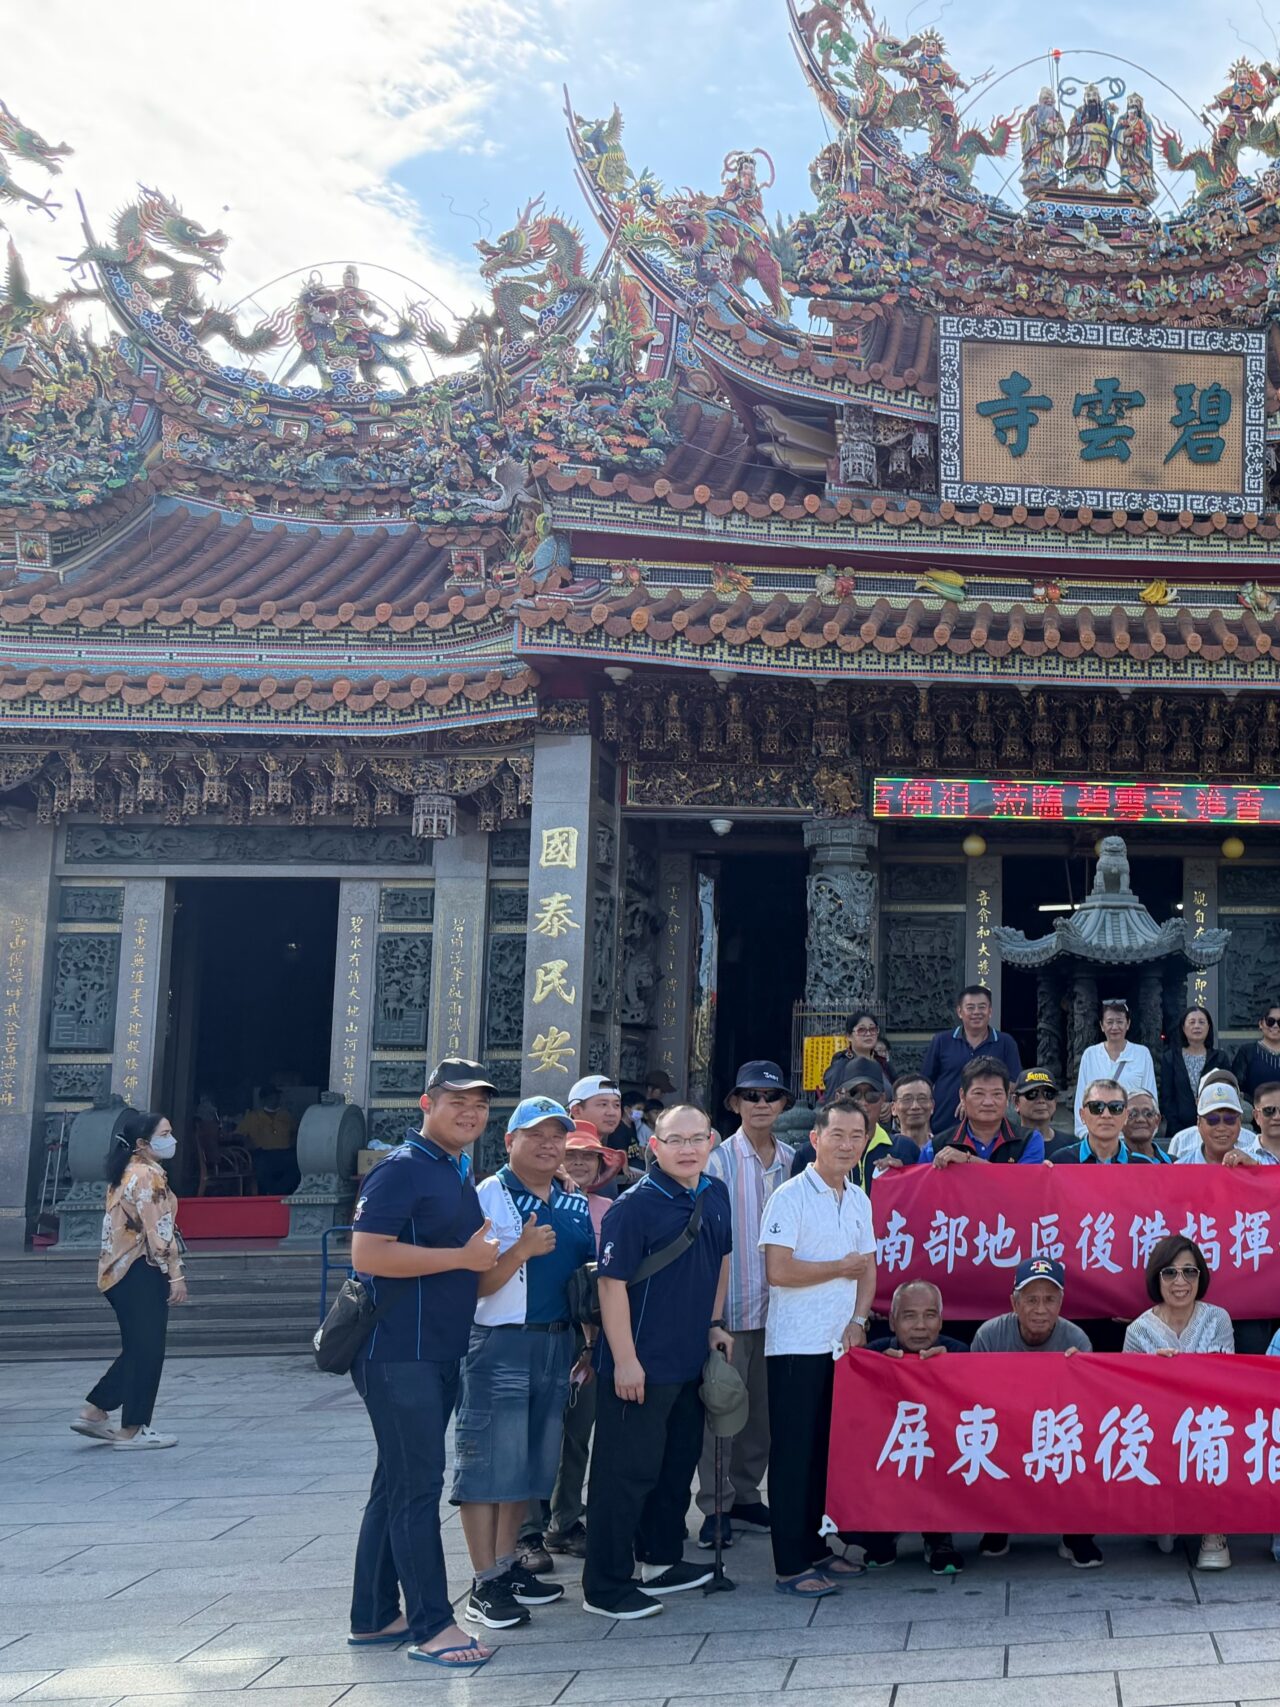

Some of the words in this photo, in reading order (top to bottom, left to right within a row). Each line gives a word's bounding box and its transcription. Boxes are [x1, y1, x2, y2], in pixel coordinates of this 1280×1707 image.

[976, 370, 1232, 465] 碧雲寺
[527, 826, 581, 1073] 國泰民安
